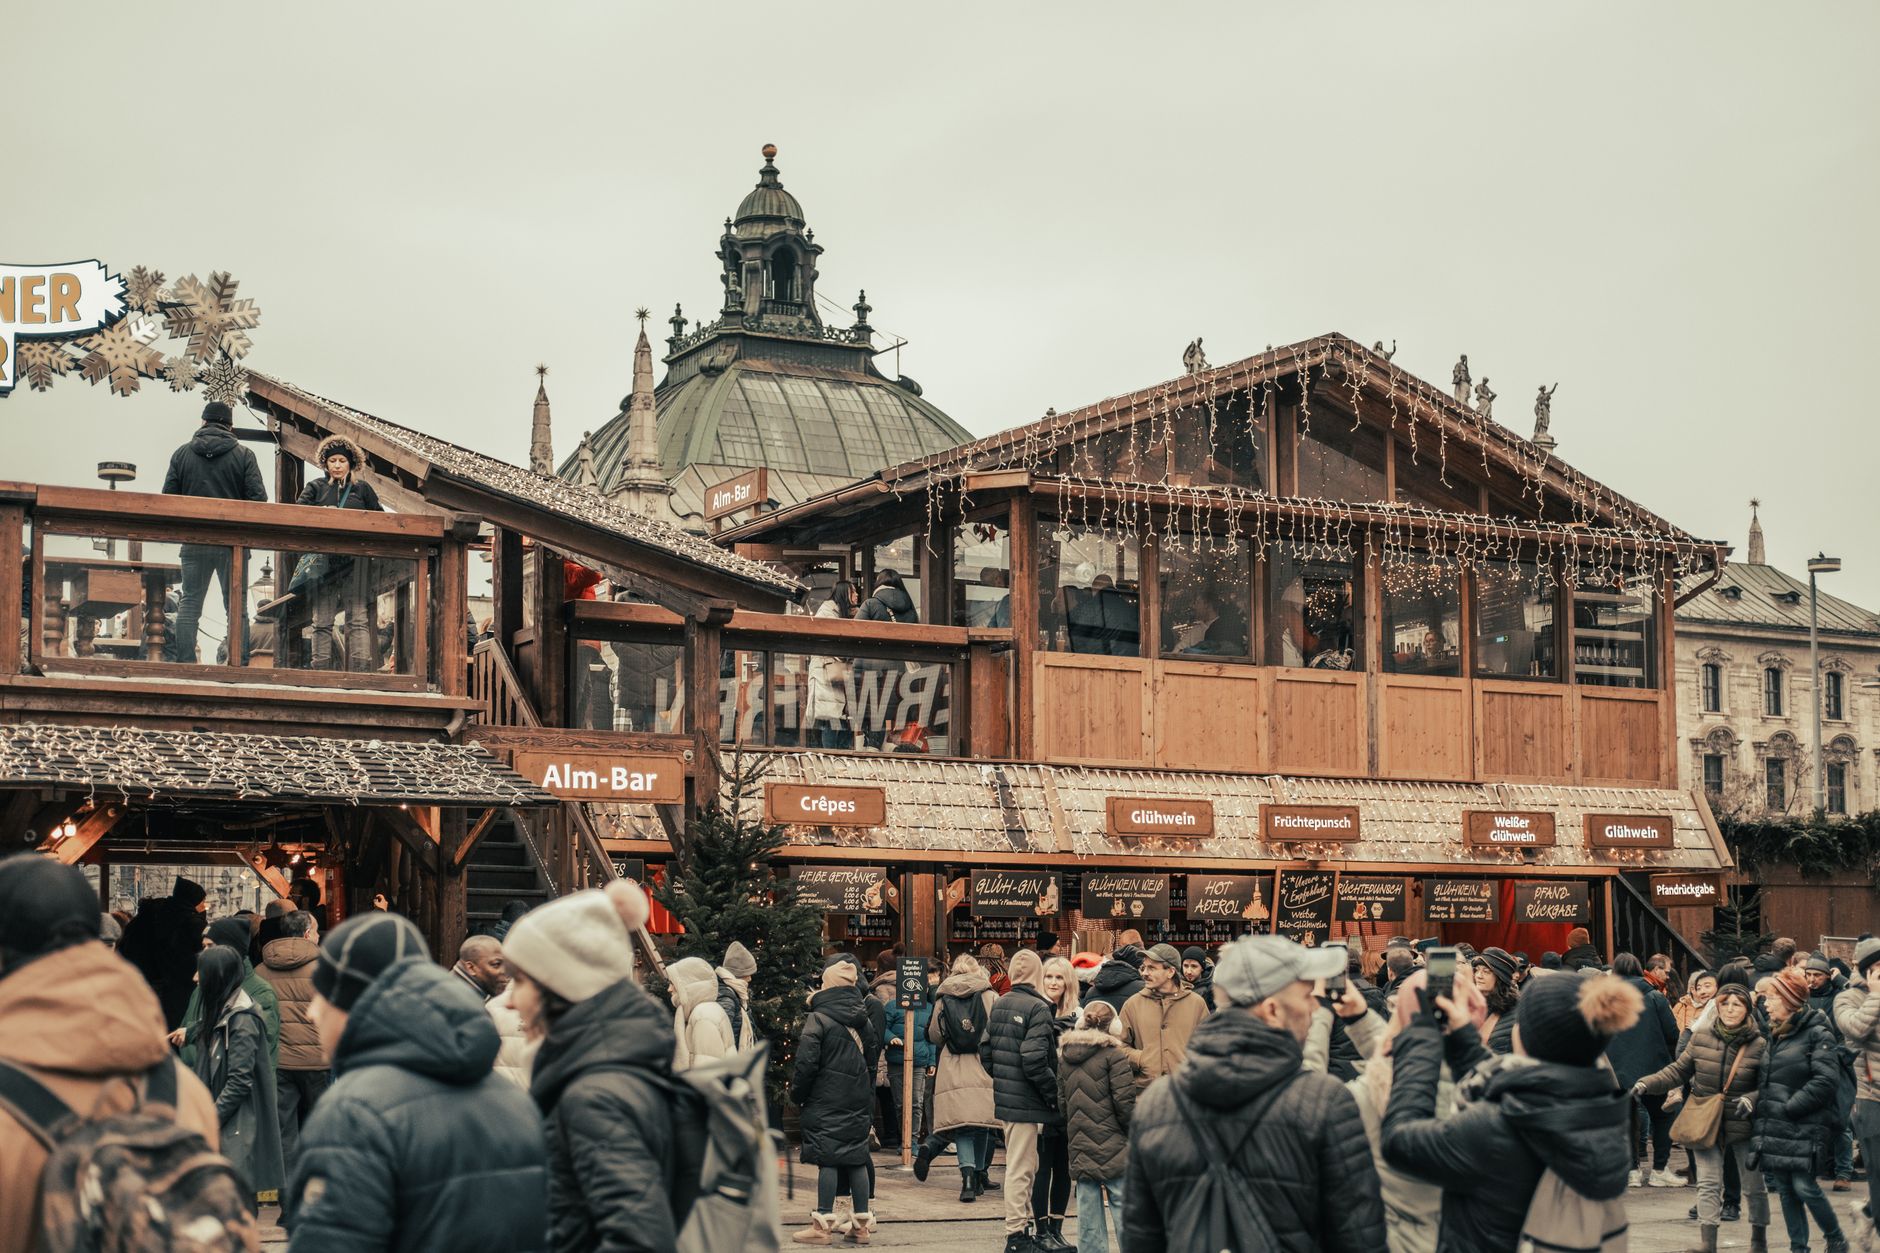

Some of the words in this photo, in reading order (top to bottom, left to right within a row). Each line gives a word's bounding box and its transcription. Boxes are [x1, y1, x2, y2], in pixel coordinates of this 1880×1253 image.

[712, 484, 750, 511] Alm-Bar
[542, 764, 657, 791] Alm-Bar
[800, 795, 856, 815] Crêpes
[1131, 810, 1196, 826] Glühwein
[1274, 815, 1351, 830] Früchtepunsch
[1494, 816, 1530, 828] Weißer
[1490, 830, 1536, 842] Glühwein
[1604, 825, 1658, 839] Glühwein
[828, 869, 877, 886] GETRÄNKE
[976, 873, 1042, 896] GLÜH-GIN
[1088, 875, 1140, 892] GLÜHWEIN
[1295, 875, 1319, 888] Unsere
[1205, 880, 1233, 896] HOT
[1290, 884, 1328, 904] Empfehlung
[1434, 881, 1479, 896] GLÜHWEIN
[1534, 886, 1570, 900] PFAND-
[1656, 883, 1715, 898] Pfandrückgabe
[1194, 898, 1239, 916] APEROL
[1526, 900, 1578, 919] RÜCKGABE
[1278, 920, 1328, 930] Bio-Glühwein
